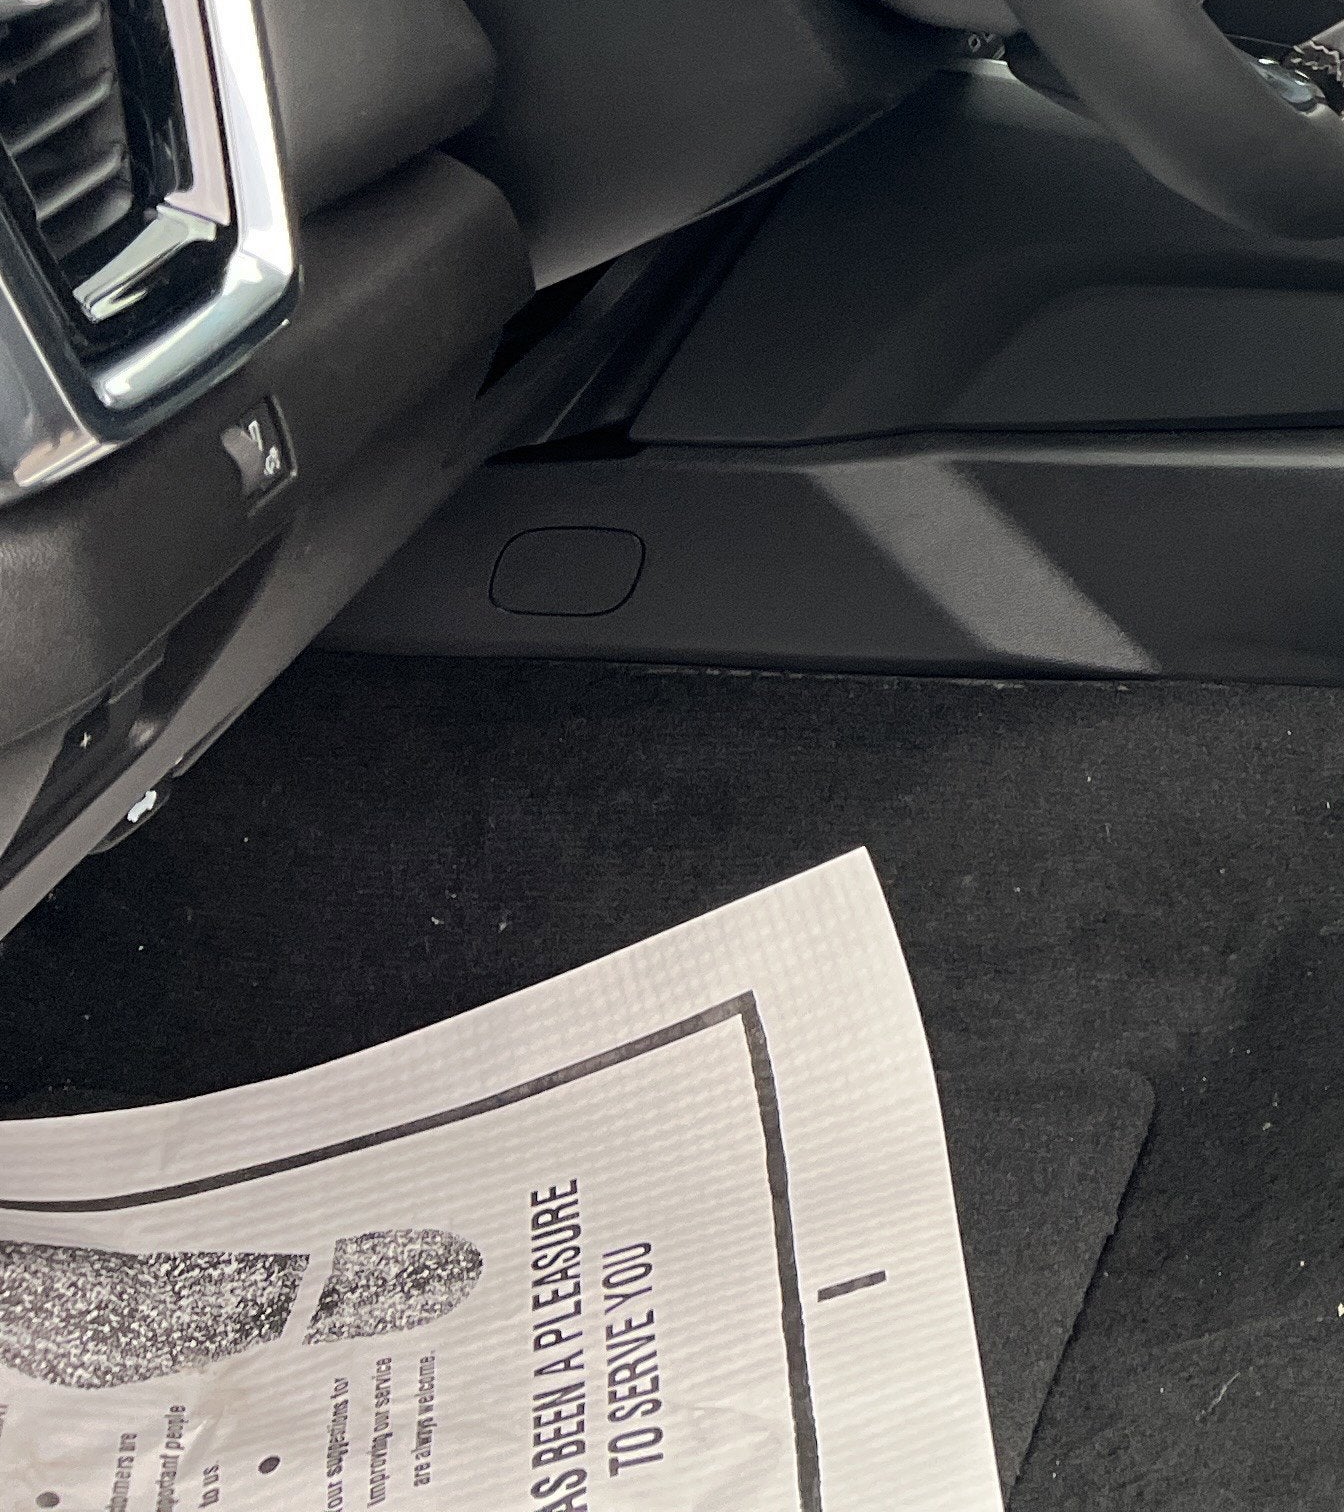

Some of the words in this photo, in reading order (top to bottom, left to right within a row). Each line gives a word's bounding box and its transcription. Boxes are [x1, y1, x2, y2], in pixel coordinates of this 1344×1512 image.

[530, 1177, 583, 1352] PLEASURE
[601, 1242, 654, 1315] YOU
[330, 1377, 349, 1399] for
[372, 1357, 392, 1408] service
[414, 1350, 436, 1416] welcome.
[533, 1349, 585, 1377] A
[605, 1308, 663, 1423] SERVE
[164, 1405, 189, 1450] people
[327, 1399, 349, 1478] suggestions
[374, 1410, 390, 1432] our
[410, 1417, 438, 1461] always
[531, 1381, 586, 1470] BEEN
[413, 1462, 431, 1487] are
[607, 1426, 665, 1478] TO
[198, 1488, 219, 1508] to
